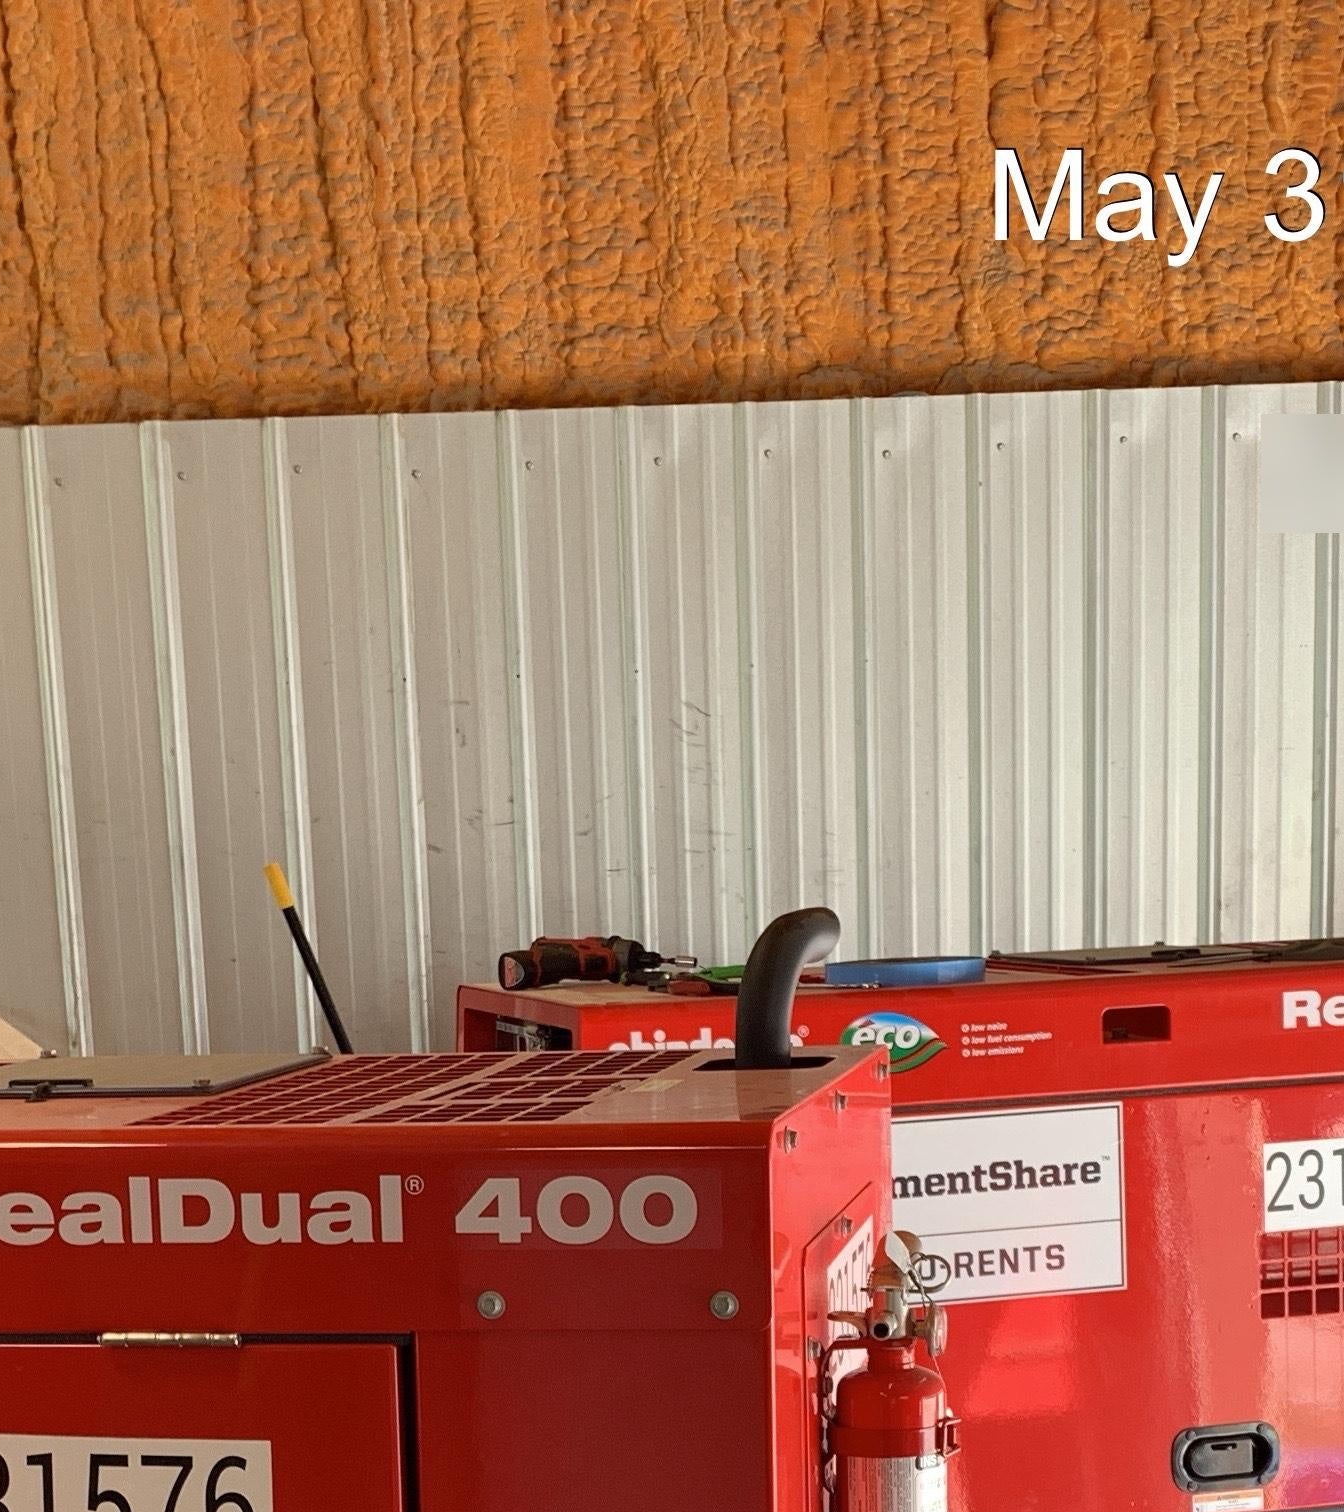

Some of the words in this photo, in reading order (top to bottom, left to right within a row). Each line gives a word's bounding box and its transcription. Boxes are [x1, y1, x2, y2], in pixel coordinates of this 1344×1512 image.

[851, 1021, 923, 1050] eco
[454, 1173, 699, 1246] 400
[919, 1244, 1066, 1282] 0-RENTS
